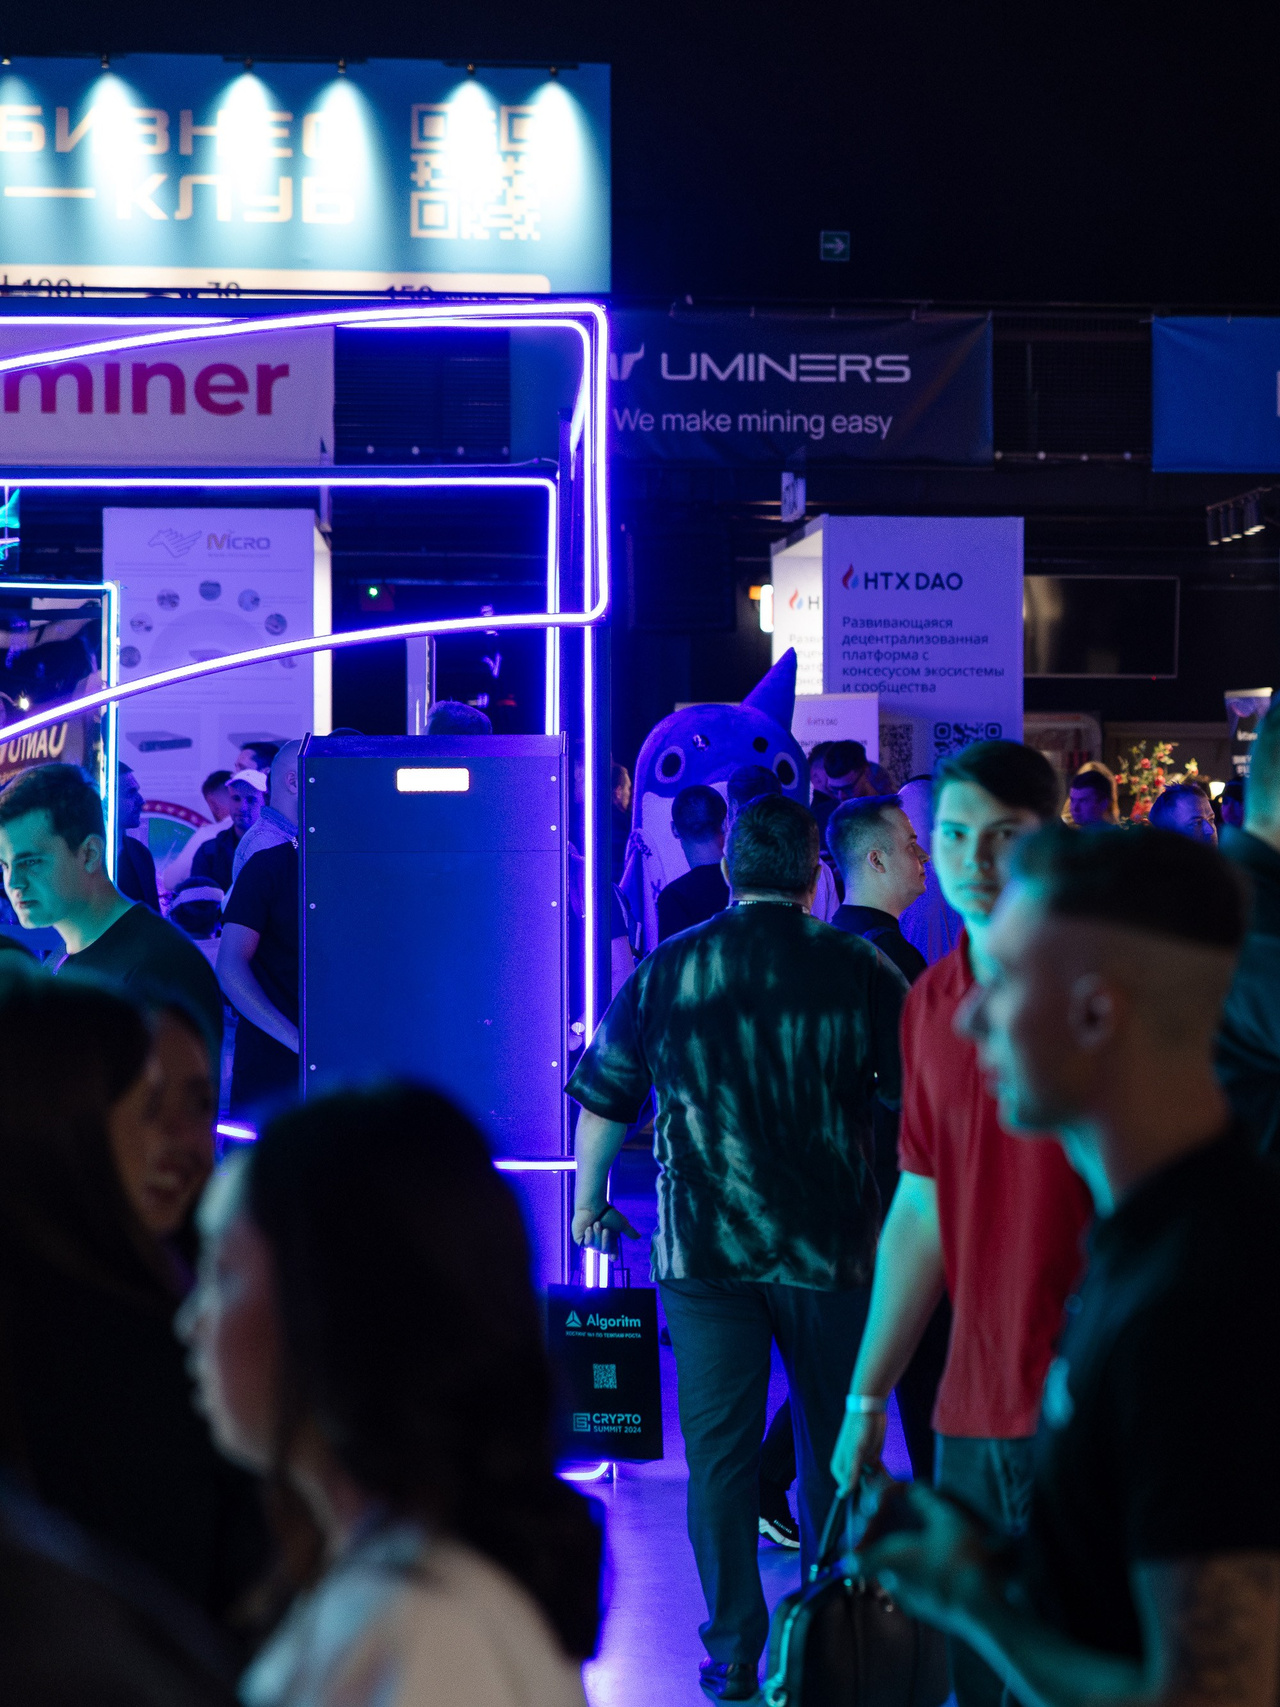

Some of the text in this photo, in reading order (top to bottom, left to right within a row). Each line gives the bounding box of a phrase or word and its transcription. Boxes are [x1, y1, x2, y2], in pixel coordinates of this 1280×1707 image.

[660, 352, 911, 382] UMINERS
[3, 356, 290, 416] miner
[613, 409, 893, 440] We make mining easy
[864, 572, 963, 590] HTX DAO
[842, 616, 953, 630] Развивающаяся
[842, 634, 989, 647] децентрализованная
[842, 649, 929, 662] платформа с
[925, 667, 1004, 677] экосистемы
[842, 680, 936, 694] и сообщества
[586, 1313, 641, 1330] Algoritm
[592, 1413, 641, 1425] CRYPTO
[593, 1425, 641, 1434] SUMMIT 2024
